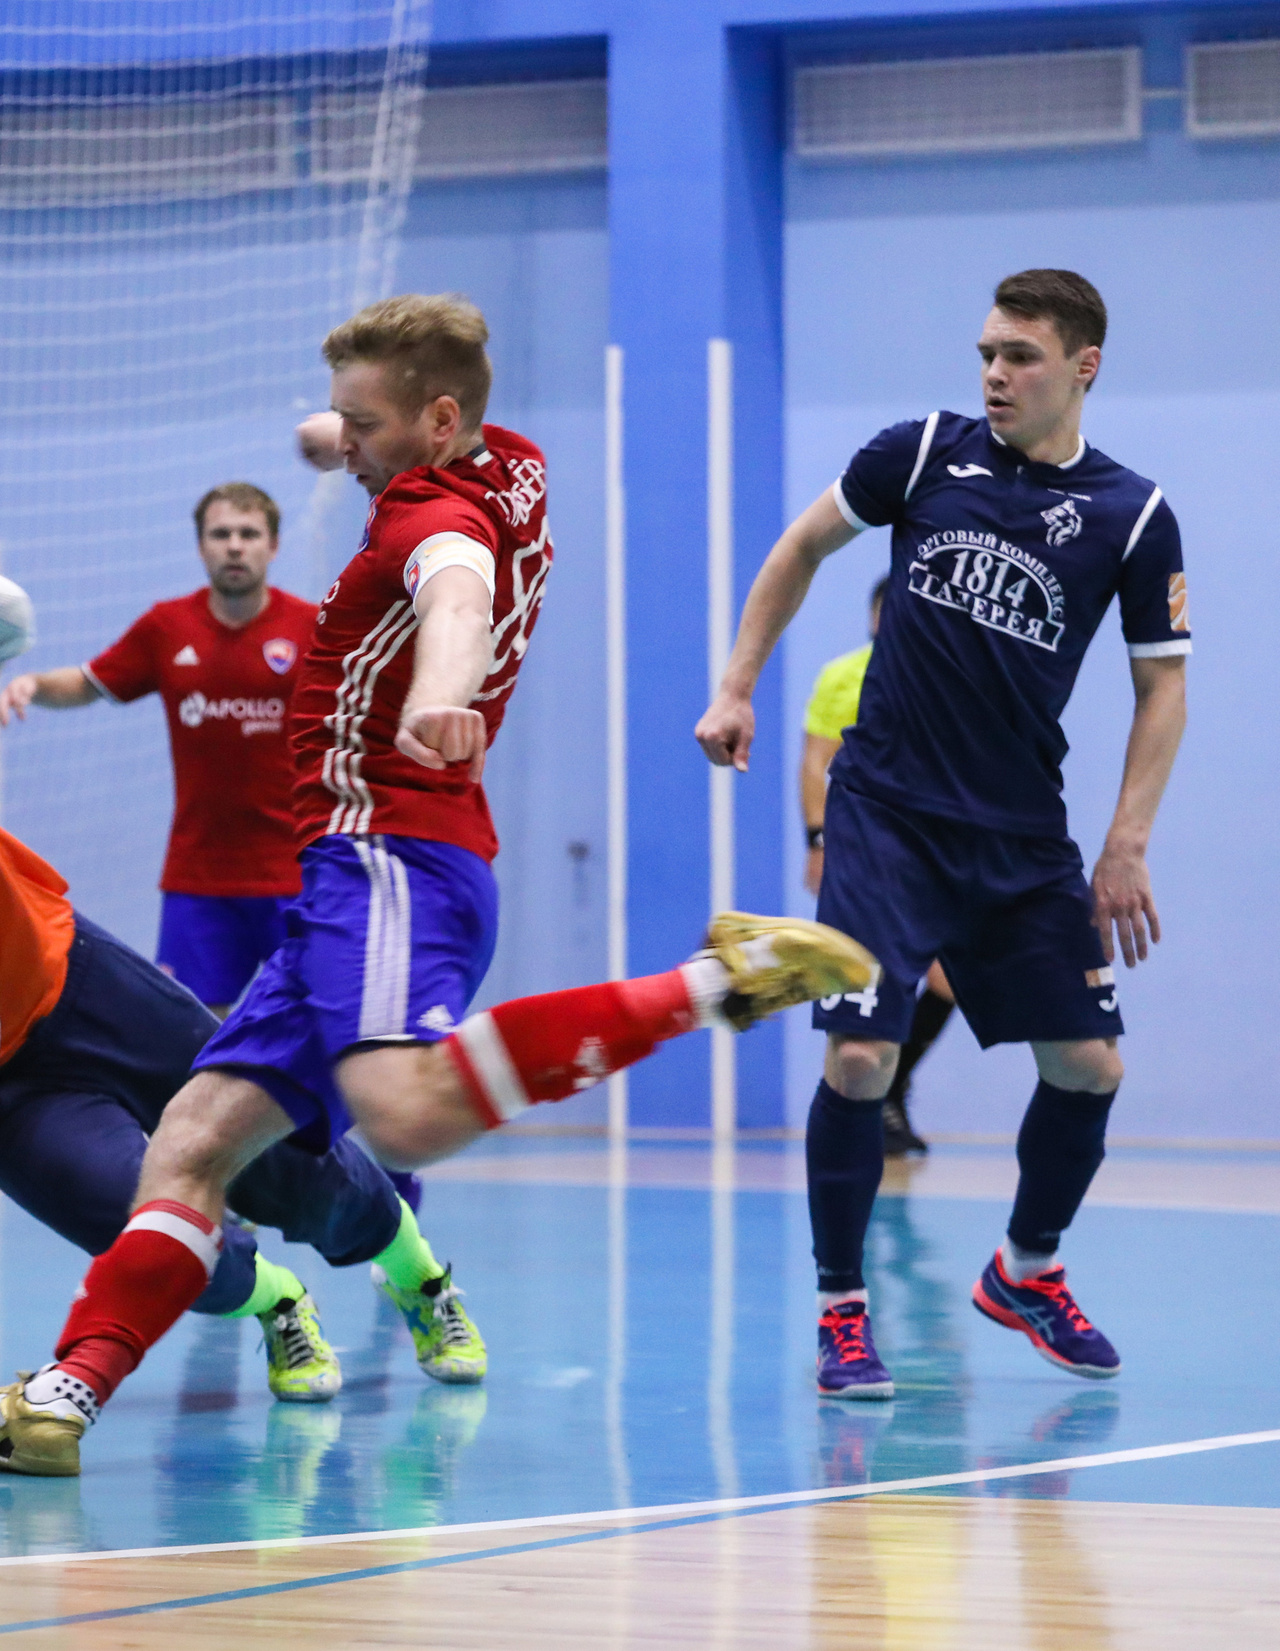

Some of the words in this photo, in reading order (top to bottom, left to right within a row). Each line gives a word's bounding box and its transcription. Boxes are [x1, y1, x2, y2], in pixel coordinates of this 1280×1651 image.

[917, 530, 997, 557] ОРГОВЫЙ
[999, 541, 1065, 620] КОМПЛЕКС
[950, 550, 1029, 609] 1814
[204, 697, 286, 720] APOLLO
